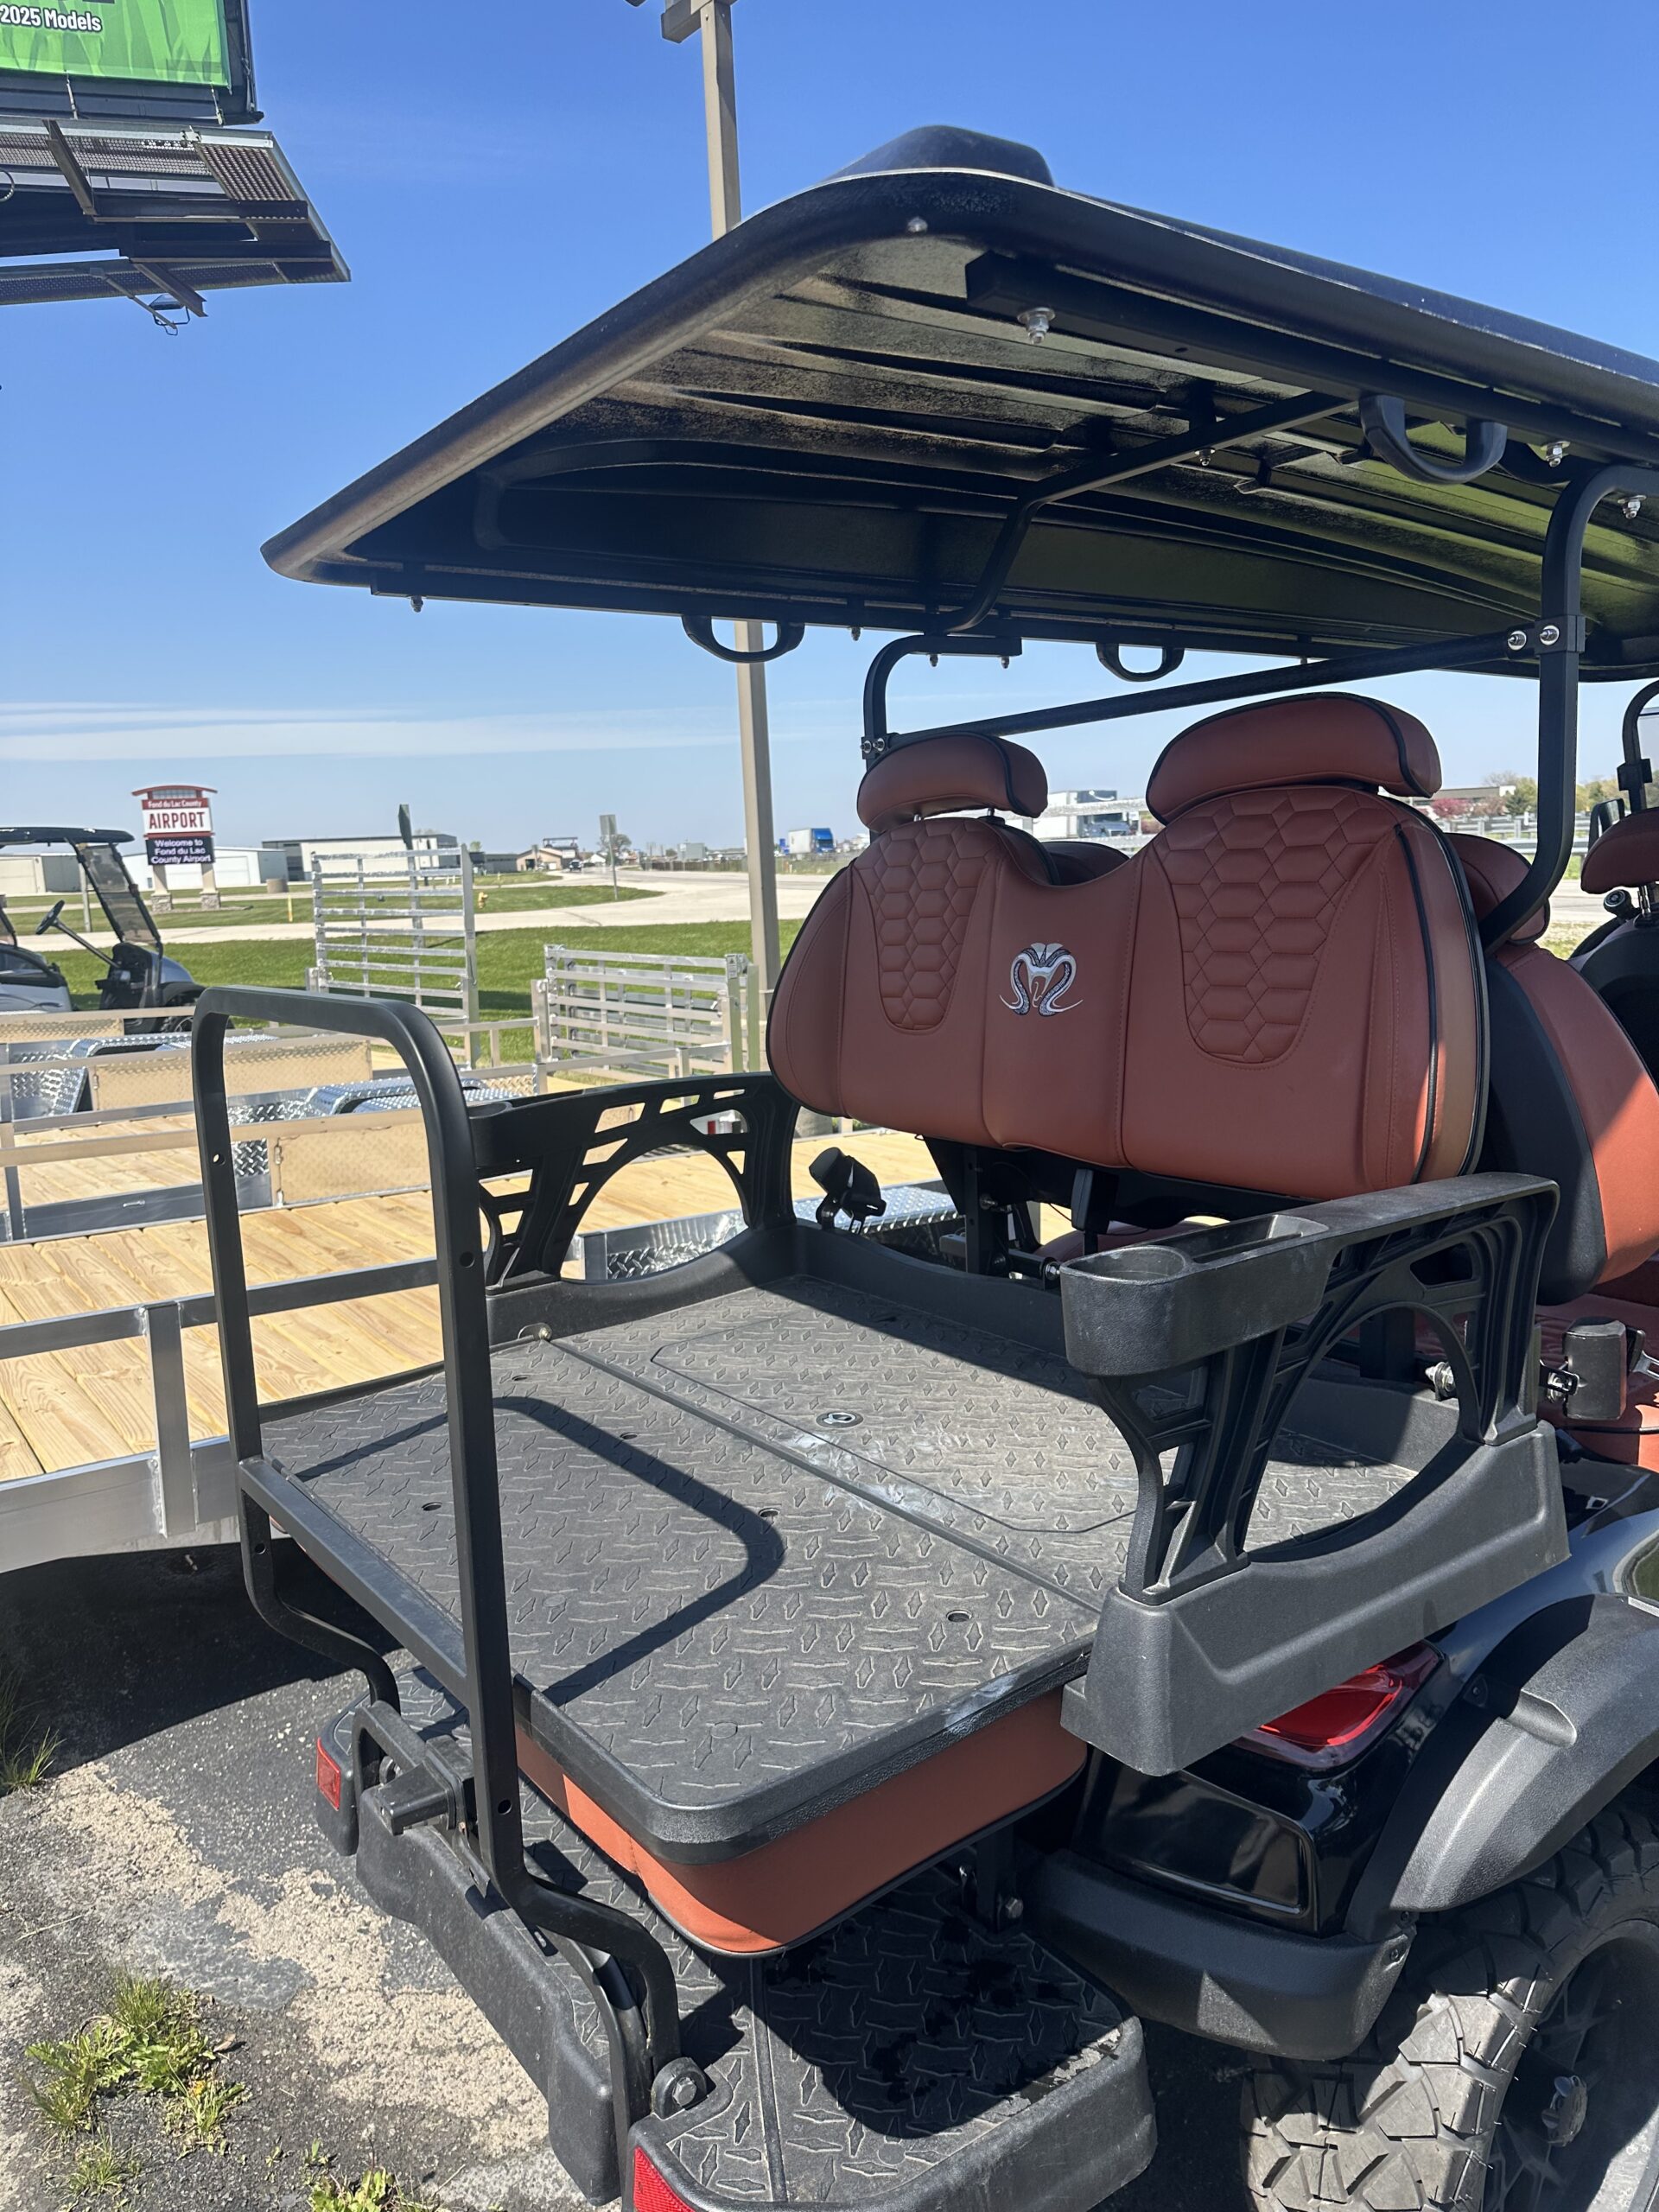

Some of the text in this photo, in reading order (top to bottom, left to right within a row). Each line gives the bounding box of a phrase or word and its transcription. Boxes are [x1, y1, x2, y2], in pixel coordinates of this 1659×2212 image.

[0, 4, 102, 32] 2025 Models
[149, 812, 205, 830] AIRPORT
